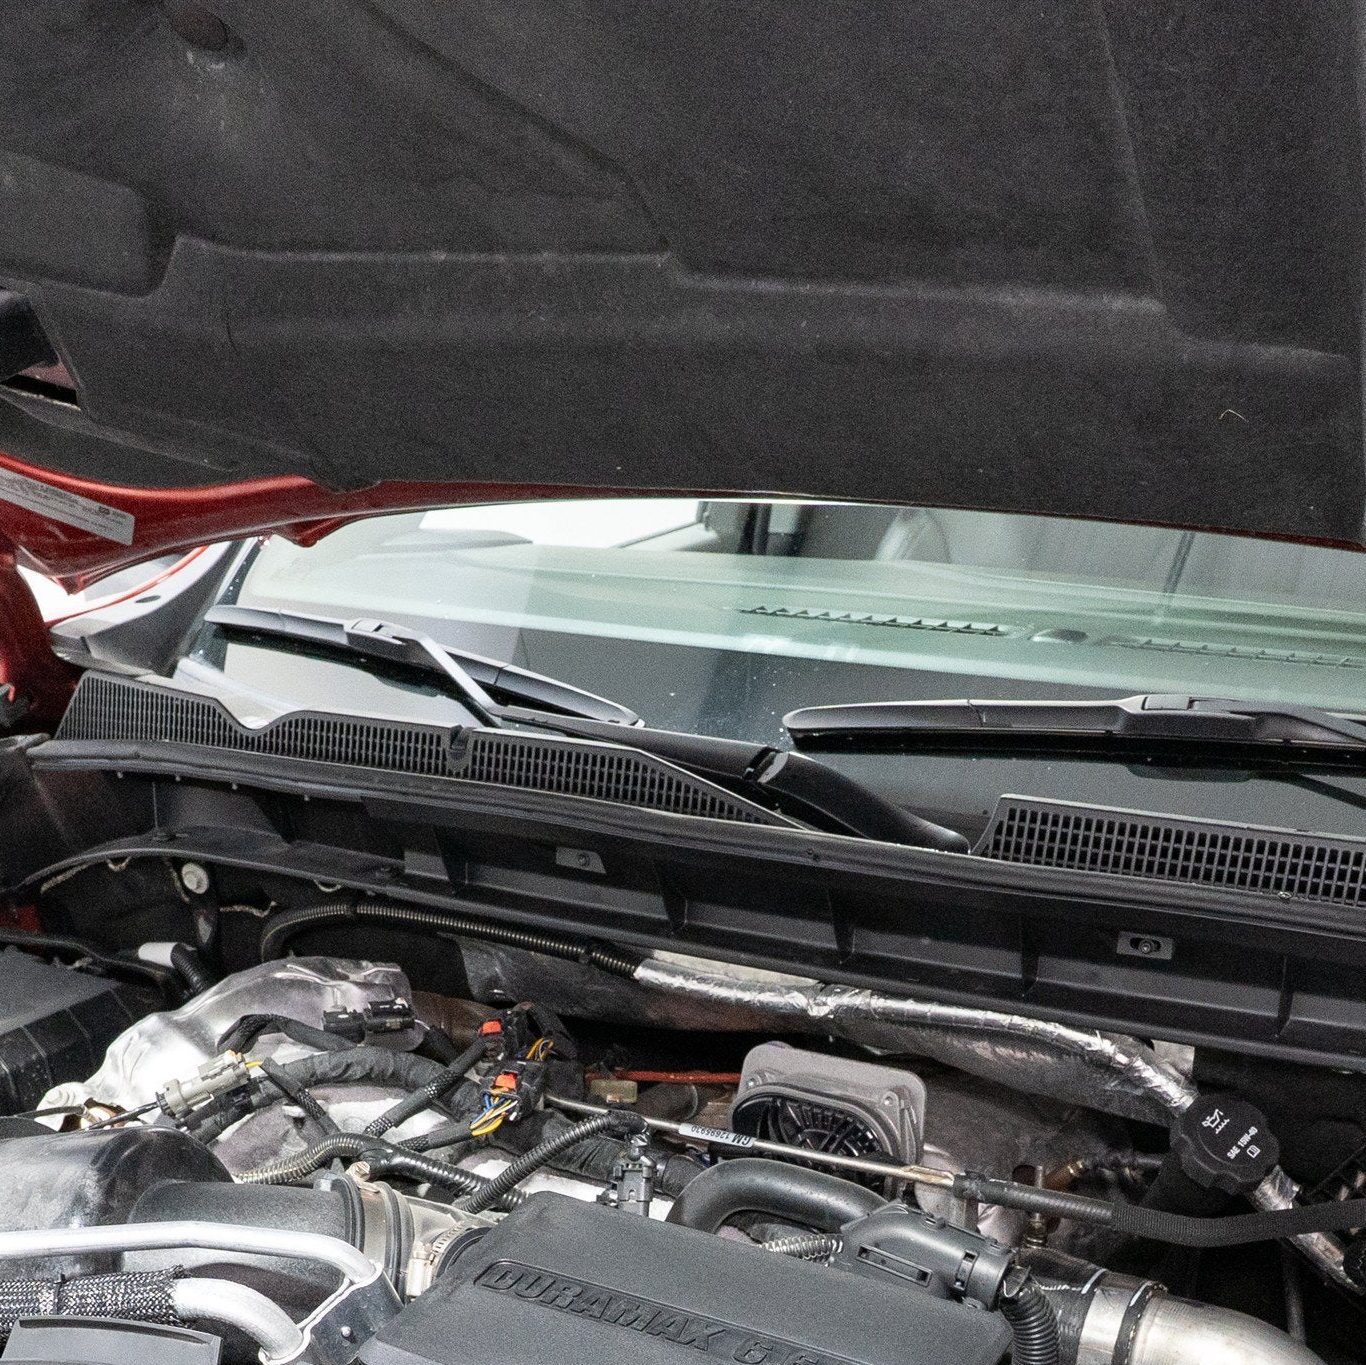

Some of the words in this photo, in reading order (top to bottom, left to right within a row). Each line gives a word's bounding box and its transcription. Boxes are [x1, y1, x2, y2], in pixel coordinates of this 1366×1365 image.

[732, 1133, 753, 1146] GM
[1227, 1145, 1241, 1160] SAE
[479, 1268, 727, 1352] DURAMAX
